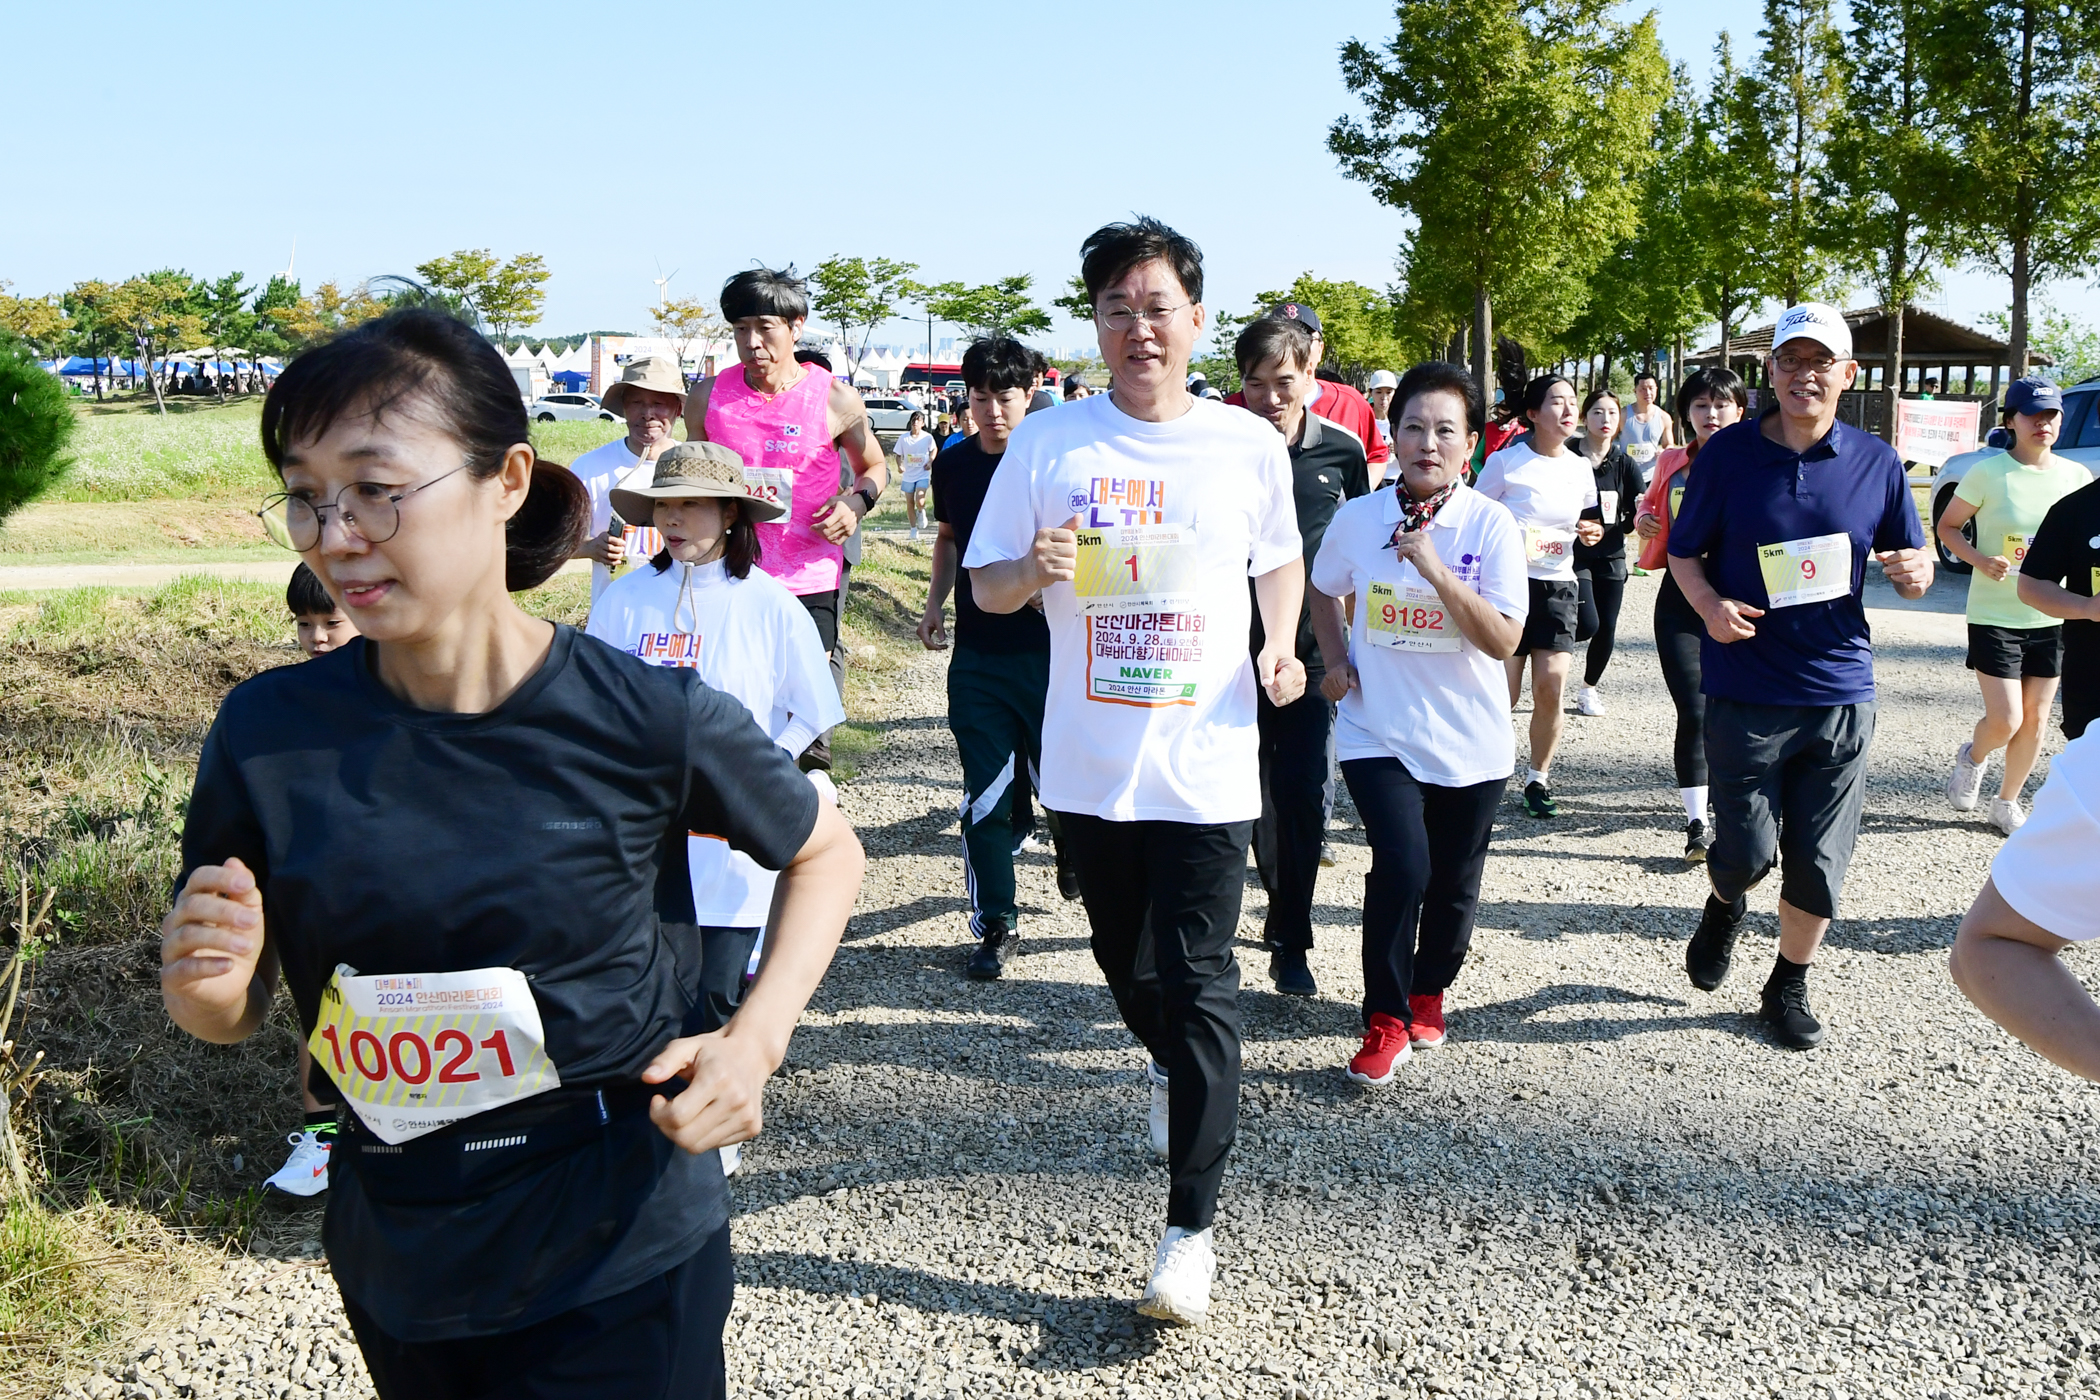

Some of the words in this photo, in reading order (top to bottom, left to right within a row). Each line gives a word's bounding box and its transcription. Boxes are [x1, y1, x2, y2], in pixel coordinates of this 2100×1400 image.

[1782, 311, 1830, 331] Titleis
[634, 345, 652, 353] 2024
[765, 439, 799, 454] SRC
[1071, 494, 1088, 507] 2024
[1090, 477, 1164, 508] 대부에서
[1077, 533, 1102, 546] 5km
[1763, 548, 1784, 558] 5km
[1125, 555, 1138, 582] 1
[1801, 559, 1816, 580] 9
[1372, 585, 1392, 596] 5km
[1095, 613, 1206, 632] 안산마라톤대회
[1382, 604, 1444, 630] 9182
[637, 632, 702, 659] 대부에서
[1096, 643, 1202, 662] 대부바다향기테마파크
[1120, 666, 1173, 679] NAVER
[1108, 684, 1126, 692] 2024
[1127, 685, 1142, 694] 안산
[1143, 686, 1166, 695] 마라톤
[375, 978, 404, 990] 대부에서
[376, 993, 414, 1005] 2024
[415, 986, 503, 1004] 안산마라톤대회
[379, 1005, 405, 1013] Ansan
[406, 1004, 447, 1013] Marathon
[448, 1003, 480, 1011] Festival
[481, 1001, 504, 1010] 2024
[321, 1024, 516, 1085] 10021
